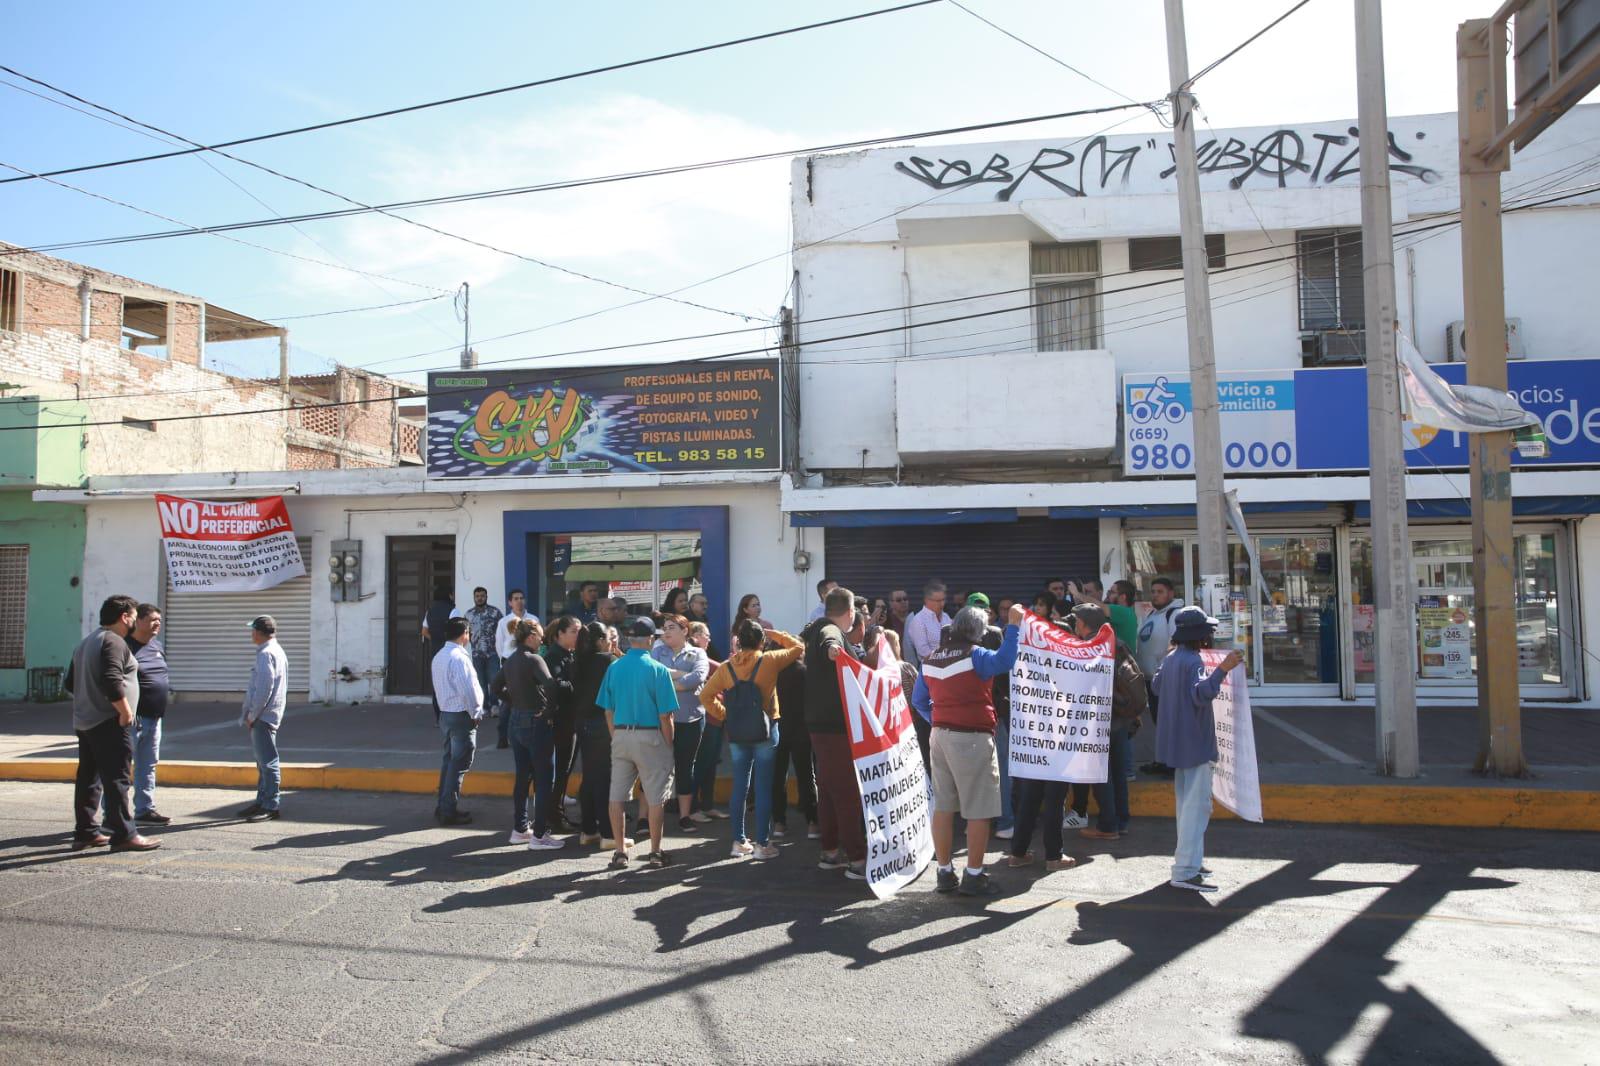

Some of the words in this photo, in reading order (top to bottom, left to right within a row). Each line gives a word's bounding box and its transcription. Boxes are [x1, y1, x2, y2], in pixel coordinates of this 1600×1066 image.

[624, 372, 712, 387] PROFESIONALES
[716, 371, 731, 382] EN
[734, 368, 774, 382] RENTA,
[636, 394, 650, 405] DE
[653, 392, 695, 405] EQUIPO
[699, 392, 713, 403] DE
[716, 389, 761, 402] SONIDO,
[1218, 382, 1260, 396] vicio
[1265, 385, 1274, 396] a
[1508, 385, 1564, 404] acias
[1217, 397, 1276, 410] micilio
[714, 409, 748, 421] VIDEO
[752, 408, 759, 420] Y
[473, 387, 581, 466] SKY
[642, 431, 680, 444] PISTAS
[684, 428, 755, 442] ILUMINADAS.
[1130, 428, 1168, 441] (669)
[634, 451, 673, 463] TEL.
[678, 450, 710, 461] 983
[716, 448, 737, 460] 58
[744, 447, 765, 459] 15
[1131, 444, 1191, 470] 980
[159, 501, 199, 535] NO
[201, 503, 217, 516] AL
[221, 502, 259, 517] CARRIL
[201, 516, 287, 535] PREFERENCIAL
[264, 535, 288, 545] ZONA
[169, 551, 208, 560] PROMUEVE
[245, 551, 258, 559] DE
[259, 542, 296, 555] FUENTES
[187, 560, 223, 569] EMPLEOS
[225, 555, 280, 570] QUEDANDO
[282, 550, 298, 559] SIN
[1038, 656, 1052, 668] LA
[1012, 669, 1023, 679] LA
[1012, 684, 1063, 702] PROMUEVE
[1065, 693, 1076, 704] EL
[1079, 694, 1105, 706] CIERRE
[1012, 700, 1053, 716] FUENTES
[1056, 708, 1073, 720] DE
[1075, 710, 1110, 722] EMPLEOS
[1012, 718, 1089, 737] QUEDANDO
[1096, 727, 1110, 738] SIN
[1012, 734, 1056, 750] SUSTENTO
[1058, 741, 1109, 754] NUMEROSAS
[1012, 751, 1050, 766] FAMILIAS.
[860, 761, 892, 783] MATA
[893, 756, 904, 771] LA
[864, 775, 914, 809] PROMUEVE
[868, 815, 886, 835] DE
[890, 792, 923, 826] EMPLEOS
[871, 814, 926, 860] SUSTENTO
